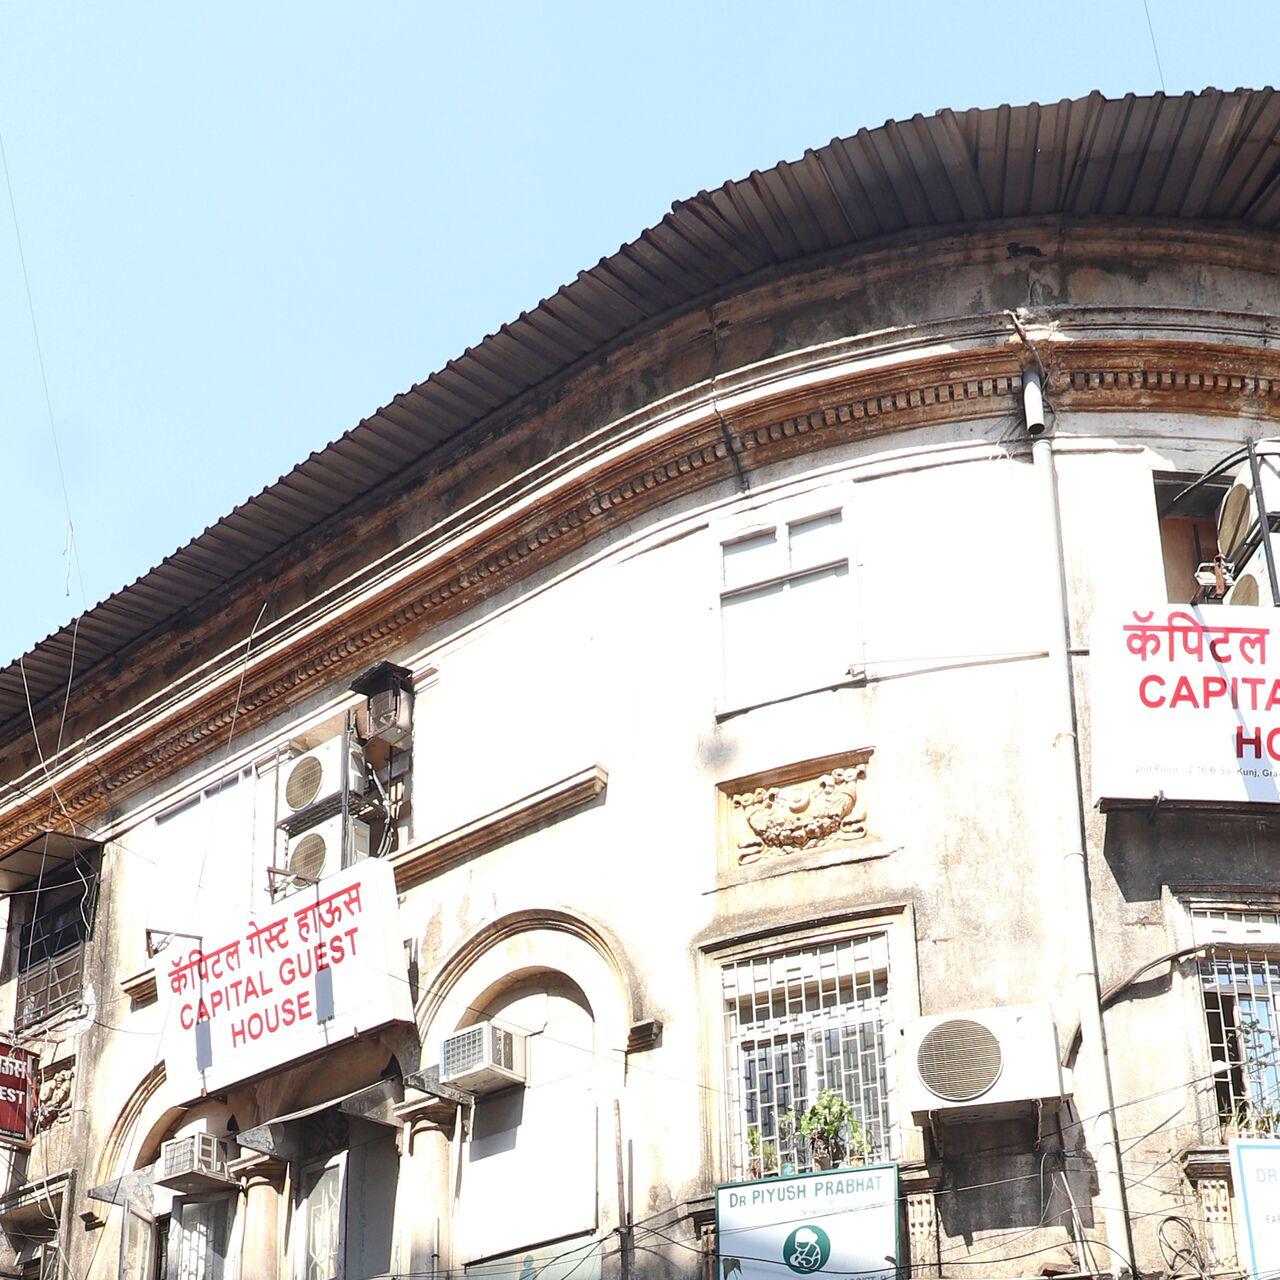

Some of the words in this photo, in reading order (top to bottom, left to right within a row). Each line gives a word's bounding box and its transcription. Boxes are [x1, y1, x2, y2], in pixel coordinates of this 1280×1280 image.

[1123, 611, 1269, 664] कॅपिटल
[1236, 767, 1260, 778] Kunj,
[168, 940, 241, 996] कॅपिटल
[246, 917, 289, 958] गेस्ट
[294, 882, 362, 943] हाऊस
[180, 971, 273, 1030] CAPITAL
[279, 927, 360, 985] GUEST
[231, 991, 312, 1048] HOUSE
[752, 1184, 807, 1206] PIYUSH
[814, 1175, 882, 1198] PRABHAT
[1256, 1168, 1278, 1184] DR
